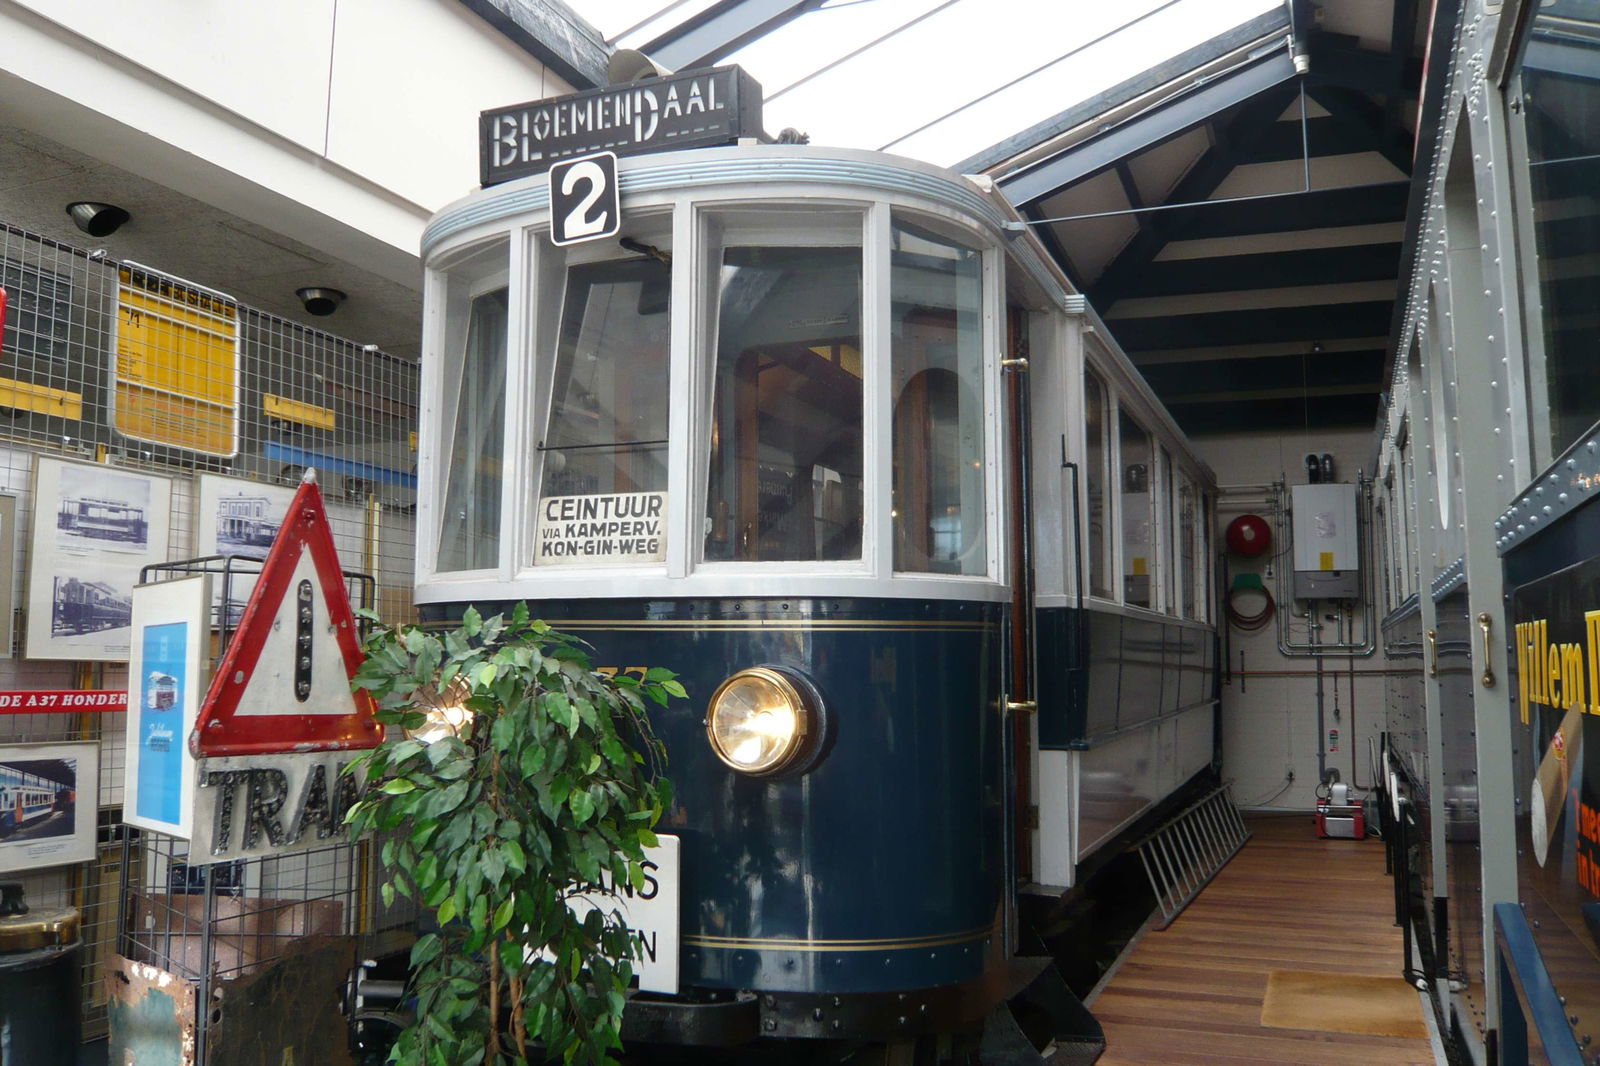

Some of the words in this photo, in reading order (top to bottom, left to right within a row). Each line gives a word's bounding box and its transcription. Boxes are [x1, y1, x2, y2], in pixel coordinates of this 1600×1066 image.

[493, 76, 725, 168] BLOEMENDAAL
[561, 160, 608, 239] 2
[546, 495, 663, 522] CEINTUUR
[542, 528, 560, 539] VIA
[565, 520, 662, 538] KAMPERV.
[542, 538, 659, 557] KON-GIN-WEG
[1515, 619, 1587, 724] Willem
[26, 694, 58, 707] A37
